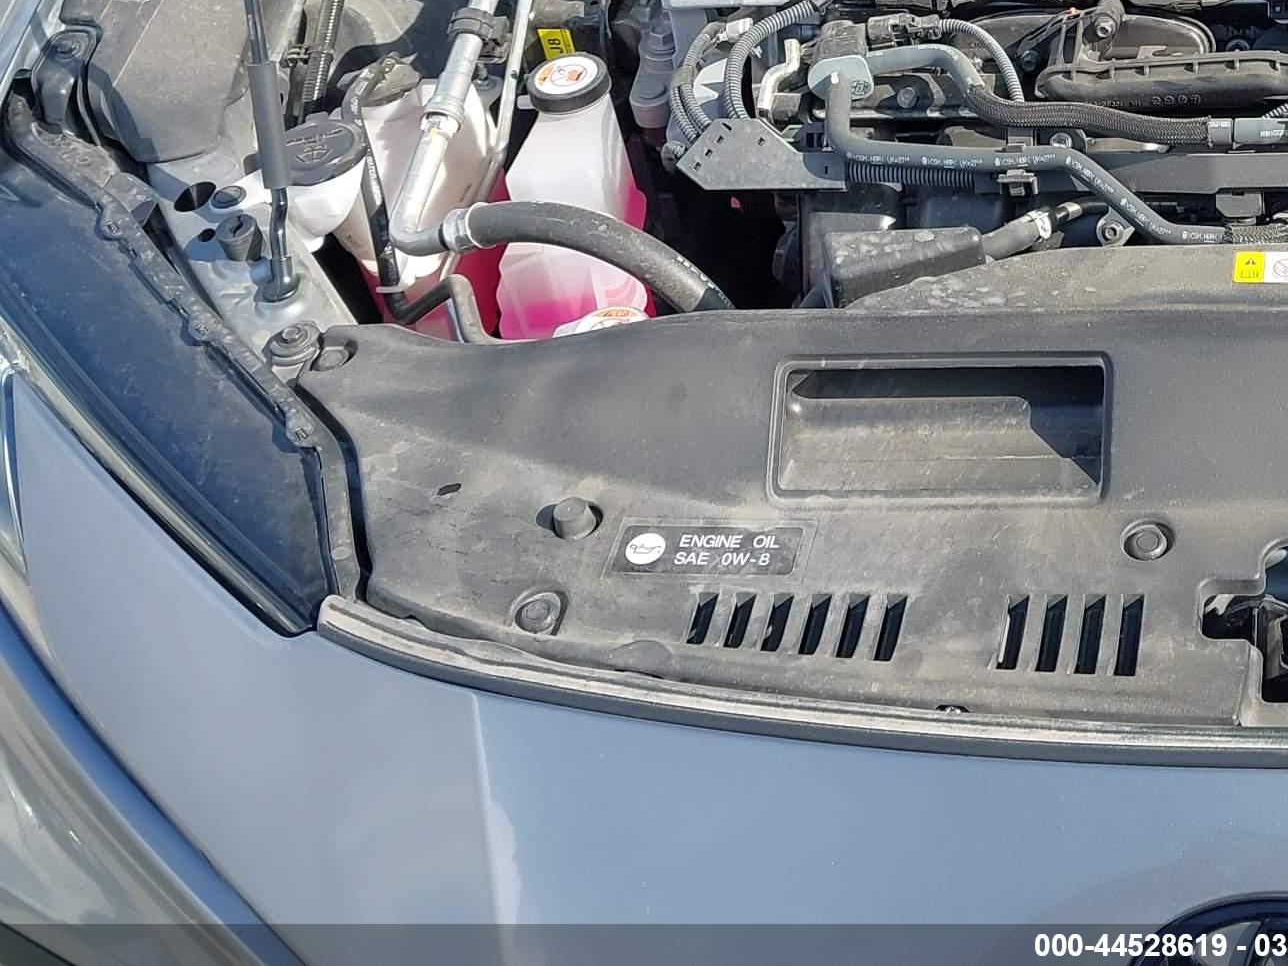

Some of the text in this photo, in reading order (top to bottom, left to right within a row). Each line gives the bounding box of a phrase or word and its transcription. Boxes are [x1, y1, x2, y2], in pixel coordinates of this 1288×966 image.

[679, 534, 780, 549] ENGINE OIL
[674, 551, 770, 566] SAE 0W-8
